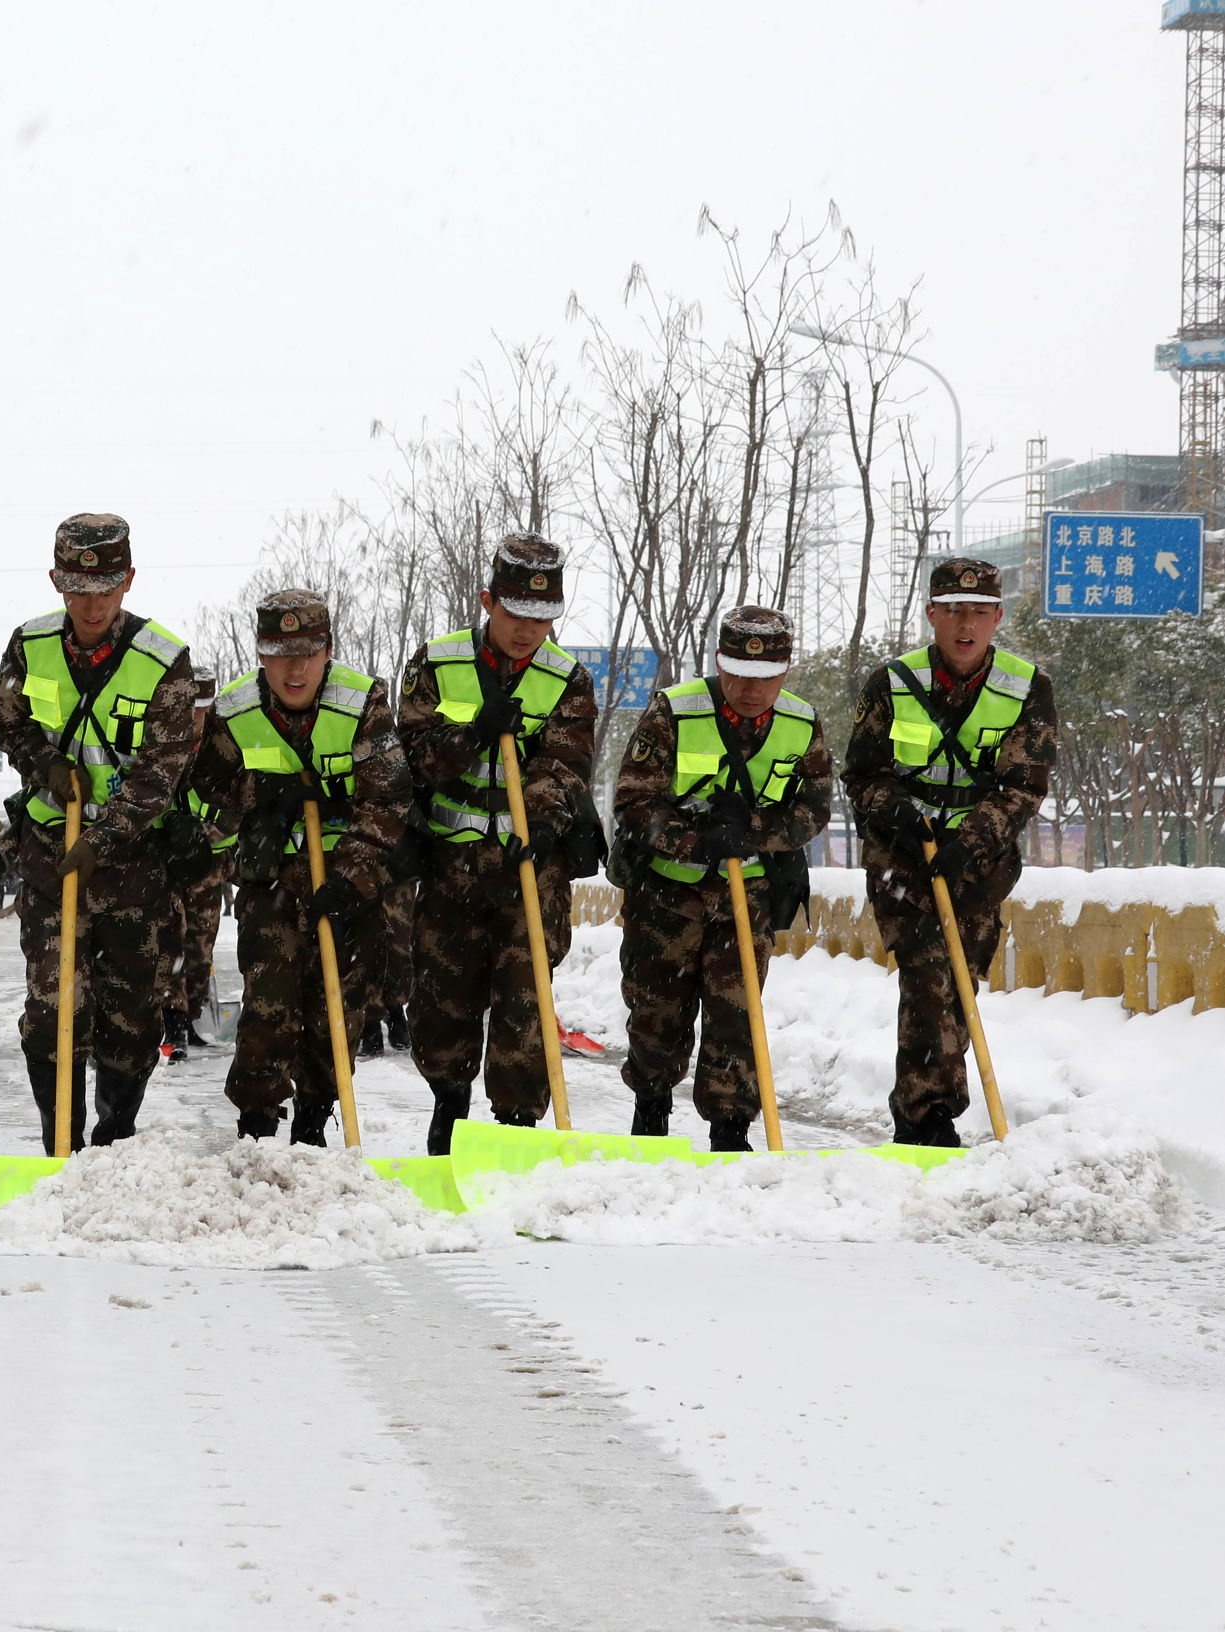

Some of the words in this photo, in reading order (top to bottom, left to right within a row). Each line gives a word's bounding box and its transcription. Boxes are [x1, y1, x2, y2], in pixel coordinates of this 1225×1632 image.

[1056, 525, 1136, 547] 北京路北
[1055, 555, 1135, 577] 上海路
[1054, 584, 1134, 606] 重庆路
